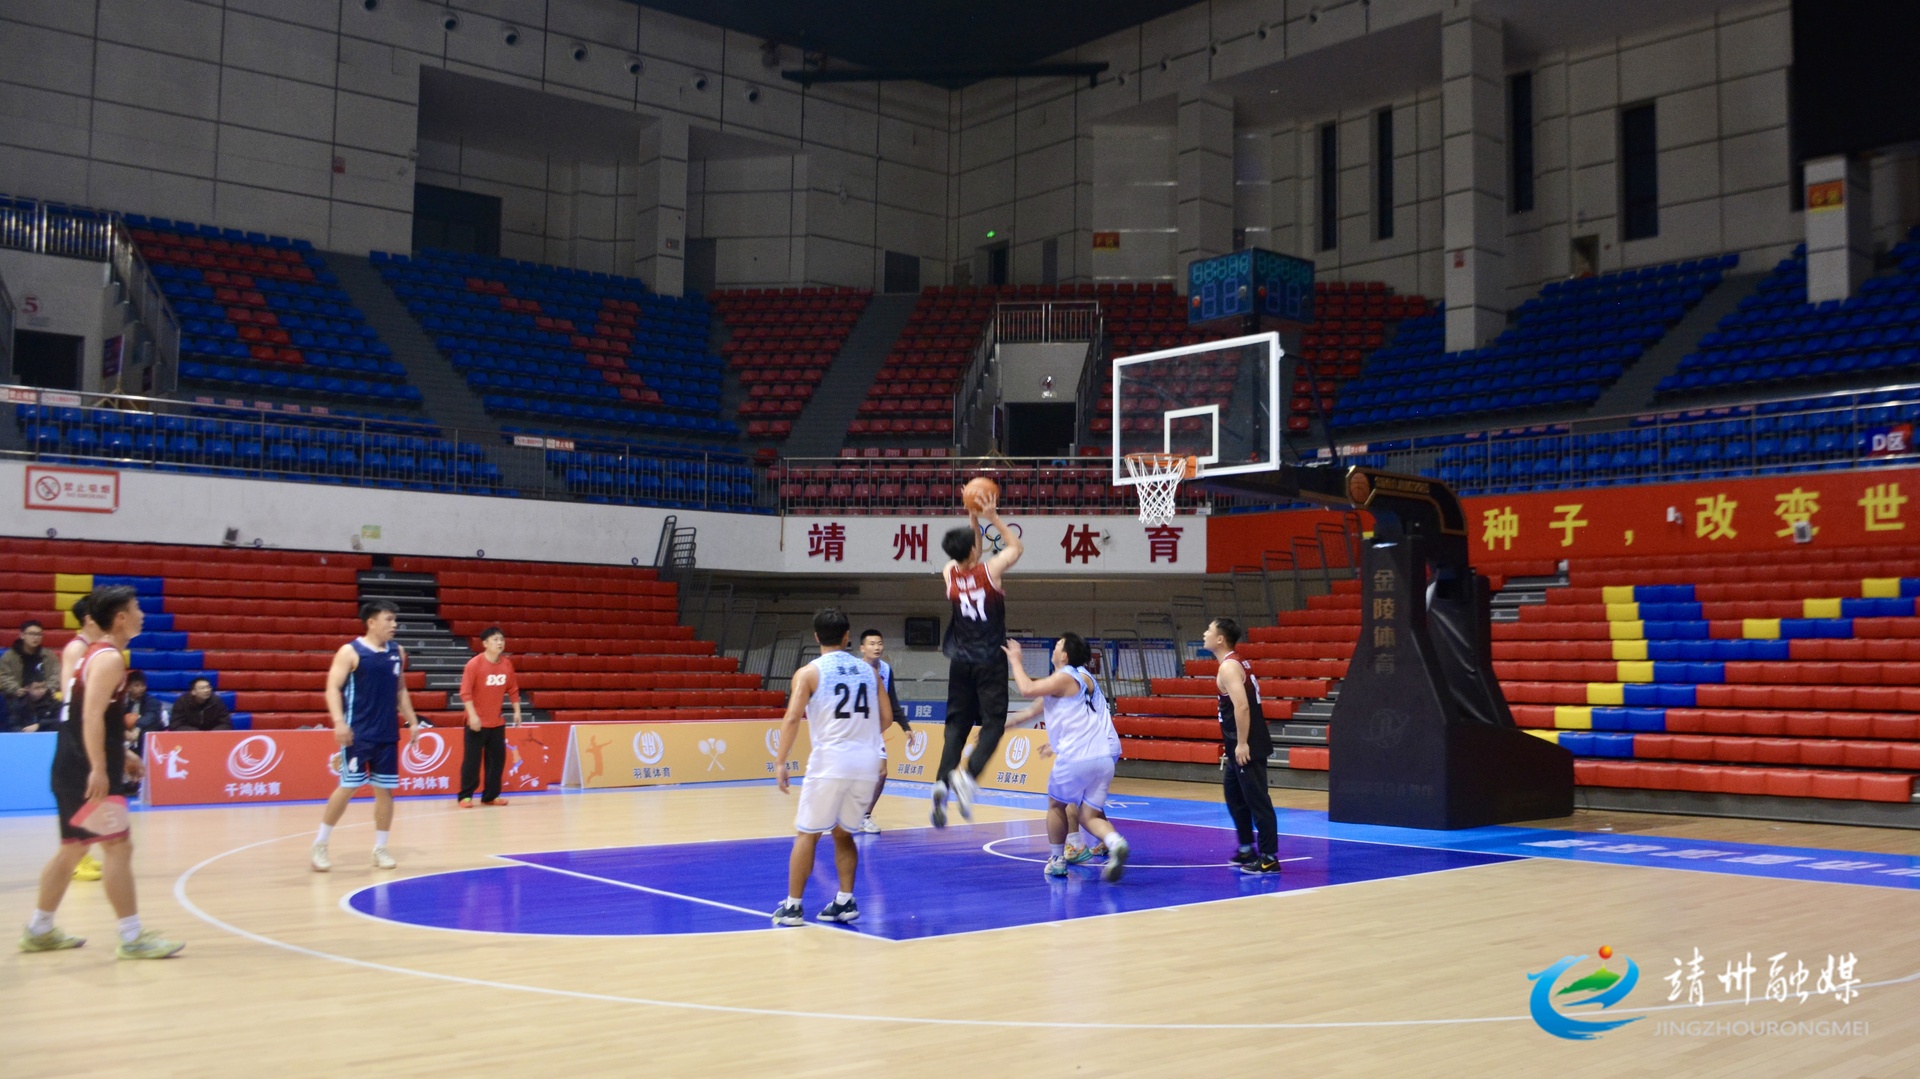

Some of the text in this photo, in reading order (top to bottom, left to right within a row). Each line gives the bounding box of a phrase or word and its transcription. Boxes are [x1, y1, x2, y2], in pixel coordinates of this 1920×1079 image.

[22, 297, 38, 314] 5
[1872, 431, 1906, 452] D区
[958, 588, 988, 622] 47
[1372, 569, 1396, 675] 金陵体育
[834, 683, 870, 719] 24
[225, 781, 281, 797] 千鸿体育
[400, 776, 450, 791] 千鸿体育
